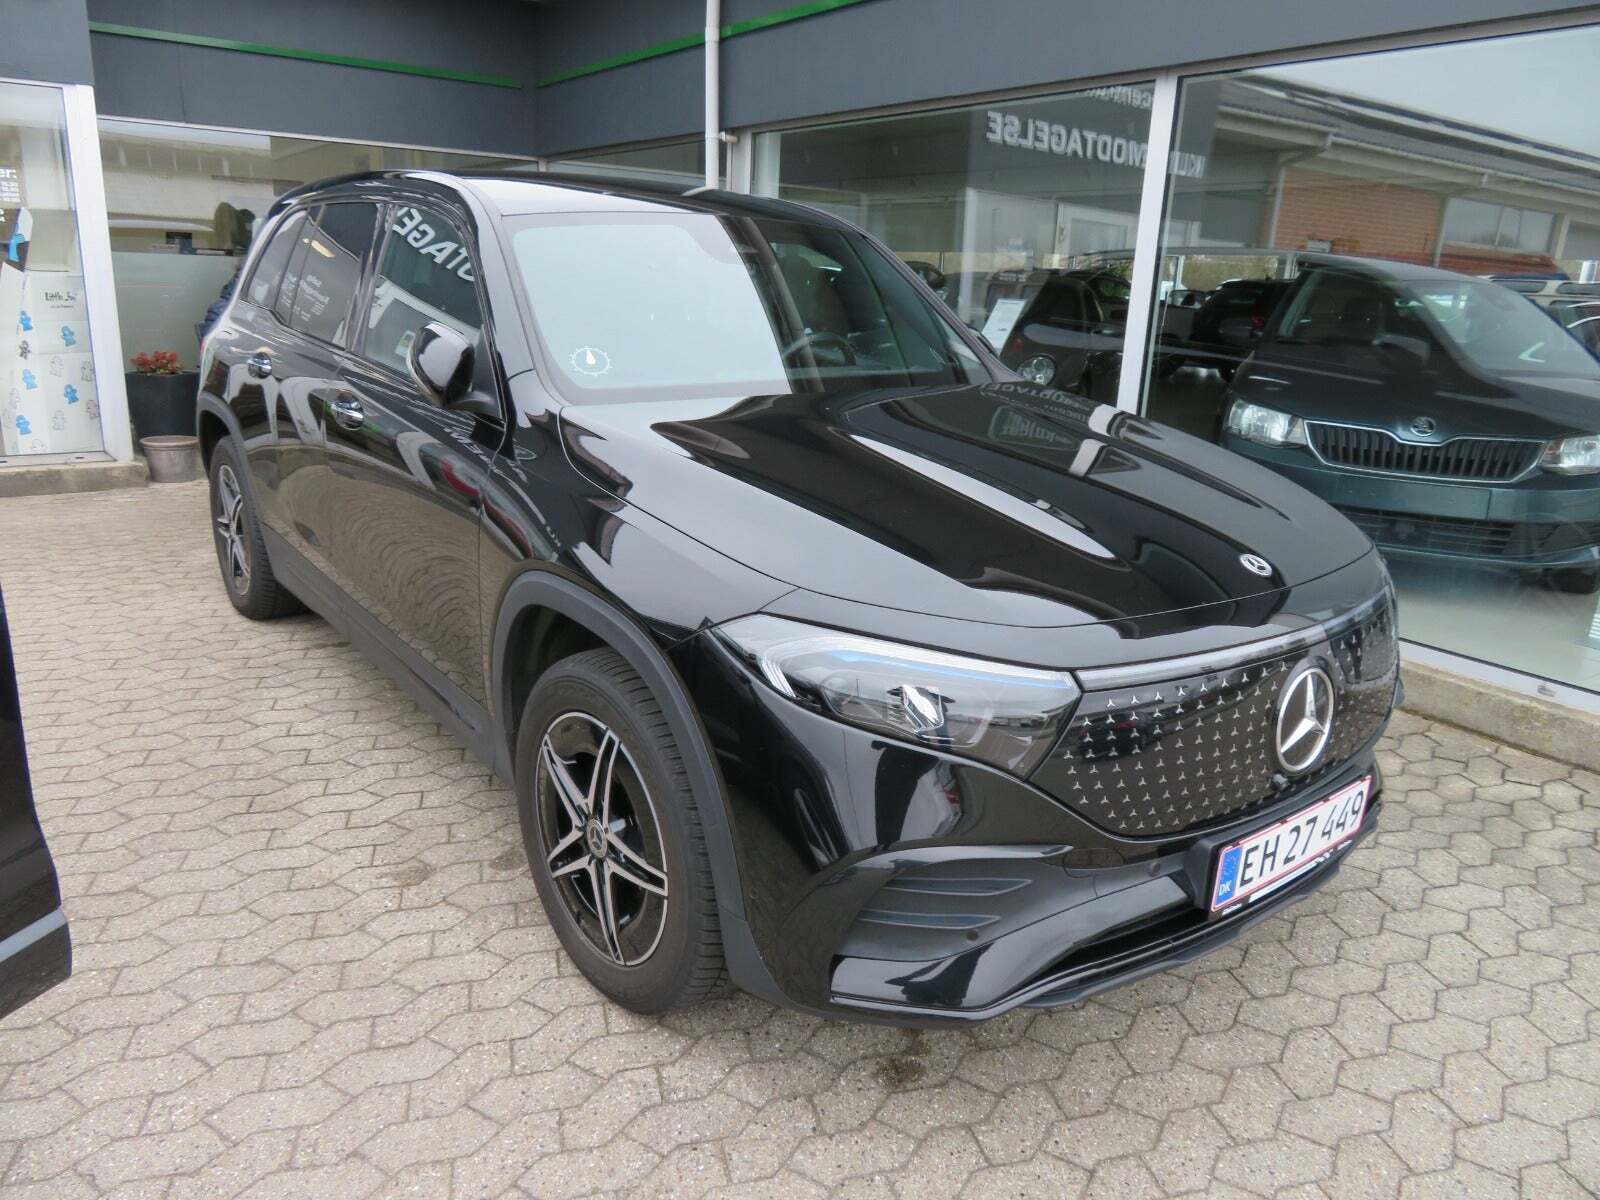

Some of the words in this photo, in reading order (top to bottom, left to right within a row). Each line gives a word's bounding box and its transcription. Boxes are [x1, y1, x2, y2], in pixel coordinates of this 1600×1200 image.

[1239, 834, 1280, 888] EH
[1283, 815, 1319, 865] 27
[1321, 790, 1364, 841] 449
[1219, 879, 1233, 896] DK
